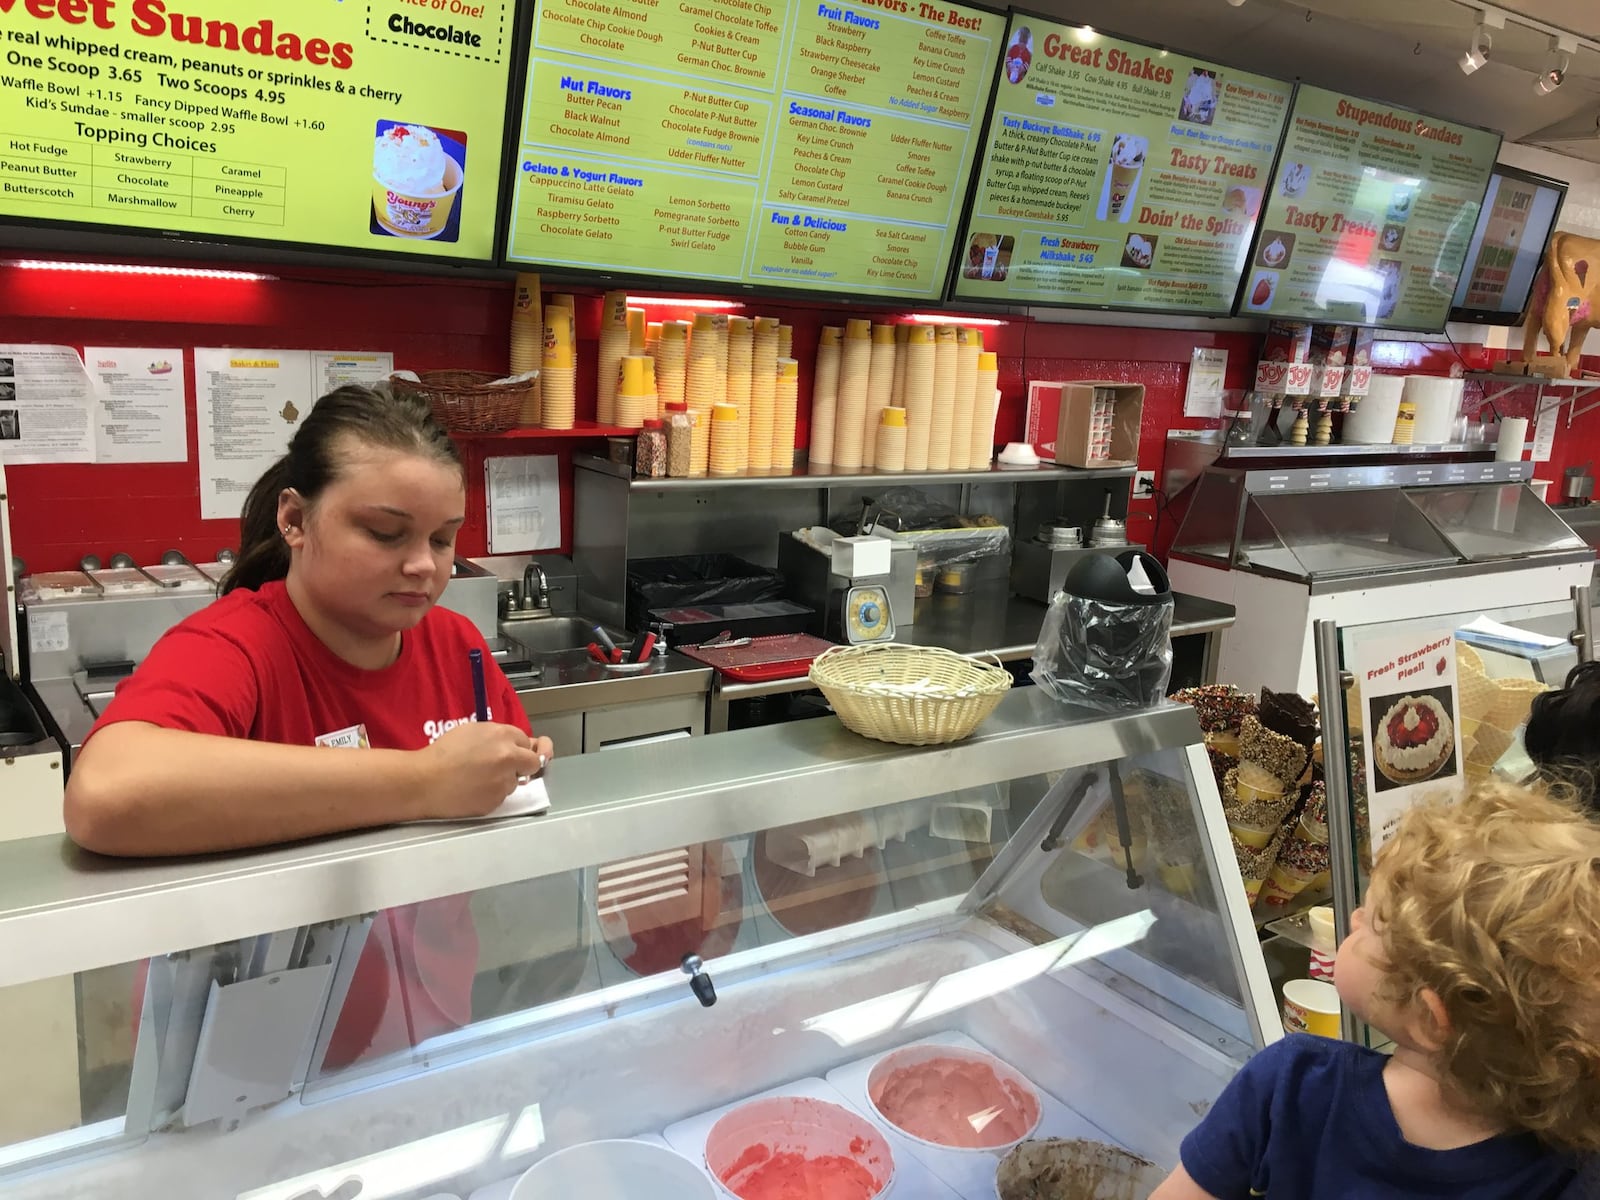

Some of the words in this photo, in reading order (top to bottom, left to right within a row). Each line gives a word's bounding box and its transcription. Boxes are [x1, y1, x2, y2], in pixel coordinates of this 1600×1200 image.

[431, 0, 447, 10] of
[450, 0, 484, 18] One!
[566, 0, 610, 14] Chocolate
[612, 6, 647, 22] Almond
[680, 3, 713, 18] Caramel
[714, 11, 754, 27] Chocolate
[756, 20, 778, 32] Toffee
[818, 4, 842, 20] Fruit
[844, 11, 880, 30] Flavors
[919, 2, 945, 22] The
[947, 10, 982, 31] Best!
[131, 0, 354, 69] Sundaes
[388, 13, 482, 47] Chocolate
[542, 10, 584, 26] Chocolate
[586, 18, 606, 32] Chip
[607, 24, 635, 36] Cookie
[637, 29, 663, 43] Dough
[827, 22, 866, 40] Strawberry
[580, 34, 624, 50] Chocolate
[692, 39, 714, 52] P-Nut
[716, 44, 740, 56] Butter
[742, 50, 757, 62] Cup
[816, 35, 834, 47] Black
[836, 40, 871, 56] Raspberry
[8, 31, 39, 45] real
[45, 35, 119, 57] whipped
[124, 50, 177, 68] cream,
[182, 58, 244, 77] peanuts
[248, 69, 263, 80] or
[268, 72, 331, 91] sprinkles
[335, 80, 344, 93] &
[348, 86, 356, 95] a
[360, 85, 402, 104] cherry
[677, 53, 710, 67] German
[711, 60, 732, 72] Choc.
[734, 64, 766, 78] Brownie
[1044, 34, 1103, 68] Great
[1106, 49, 1173, 84] Shakes
[7, 51, 43, 68] One
[48, 56, 99, 79] Scoop
[108, 66, 142, 83] 3.65
[158, 73, 189, 90] Two
[194, 79, 247, 100] Scoops
[255, 89, 285, 104] 4.95
[811, 66, 837, 80] Orange
[838, 72, 865, 84] Sherbet
[1035, 62, 1048, 73] Calf
[1049, 65, 1066, 77] Shake
[1085, 73, 1097, 83] Cow
[1098, 76, 1114, 88] Shake
[1132, 84, 1143, 93] Bull
[1143, 86, 1159, 97] Shake
[561, 77, 584, 92] Nut
[588, 81, 631, 100] Flavors
[1, 76, 44, 91] Waffle
[48, 82, 79, 96] Bowl
[87, 89, 122, 102] +1.15
[136, 94, 171, 111] Fancy
[174, 100, 219, 118] Dipped
[221, 106, 258, 121] Waffle
[261, 112, 288, 126] Bowl
[293, 119, 325, 131] +1.60
[567, 93, 594, 106] Butter
[596, 98, 622, 111] Pecan
[26, 96, 56, 110] Kid's
[61, 101, 109, 117] Sundae
[121, 112, 166, 124] smaller
[170, 118, 204, 132] scoop
[210, 121, 235, 134] 2.95
[564, 110, 588, 122] Black
[590, 114, 620, 127] Walnut
[789, 102, 835, 120] Seasonal
[837, 111, 871, 127] Flavors
[1336, 99, 1413, 134] Stupendous
[1414, 119, 1464, 146] Sundaes
[74, 122, 147, 148] Topping
[152, 132, 216, 152] Choices
[10, 140, 30, 151] Hot
[34, 143, 68, 156] Fudge
[668, 148, 693, 159] Udder
[694, 152, 720, 163] Fluffer
[721, 156, 745, 167] Nutter
[1, 161, 39, 174] Peanut
[43, 166, 76, 177] Butter
[115, 153, 172, 169] Strawberry
[1170, 148, 1211, 175] Tasty
[1214, 156, 1257, 179] Treats
[117, 174, 168, 187] Chocolate
[222, 166, 260, 178] Caramel
[523, 161, 558, 176] Gelato
[560, 166, 570, 176] &
[573, 168, 606, 182] Yogurt
[609, 173, 642, 187] Flavors
[4, 183, 74, 198] Butterscotch
[216, 185, 263, 198] Pineapple
[530, 174, 581, 190] Cappuccino
[584, 182, 605, 192] Latte
[607, 185, 634, 196] Gelato
[108, 194, 177, 208] Marshmallow
[386, 190, 437, 211] Young's
[548, 193, 584, 206] Tiramisu
[586, 198, 614, 209] Gelato
[669, 196, 696, 206] Lemon
[698, 200, 730, 211] Sorbetto
[223, 206, 254, 218] Cherry
[537, 208, 581, 222] Raspberry
[584, 213, 620, 225] Sorbetto
[654, 208, 706, 222] Pomegranate
[708, 216, 740, 227] Sorbetto
[772, 212, 790, 225] Fun
[792, 215, 801, 226] &
[804, 216, 846, 232] Delicious
[1138, 207, 1179, 227] Doin'
[1181, 214, 1203, 230] the
[1206, 216, 1244, 236] Splits
[1286, 206, 1329, 234] Tasty
[1331, 213, 1376, 238] Treats
[784, 227, 808, 237] Cotton
[809, 230, 830, 241] Candy
[1040, 236, 1060, 247] Fresh
[1061, 238, 1099, 253] Strawberry
[1367, 661, 1396, 681] Fresh
[1398, 636, 1451, 667] Strawberry
[330, 735, 352, 747] EMILY
